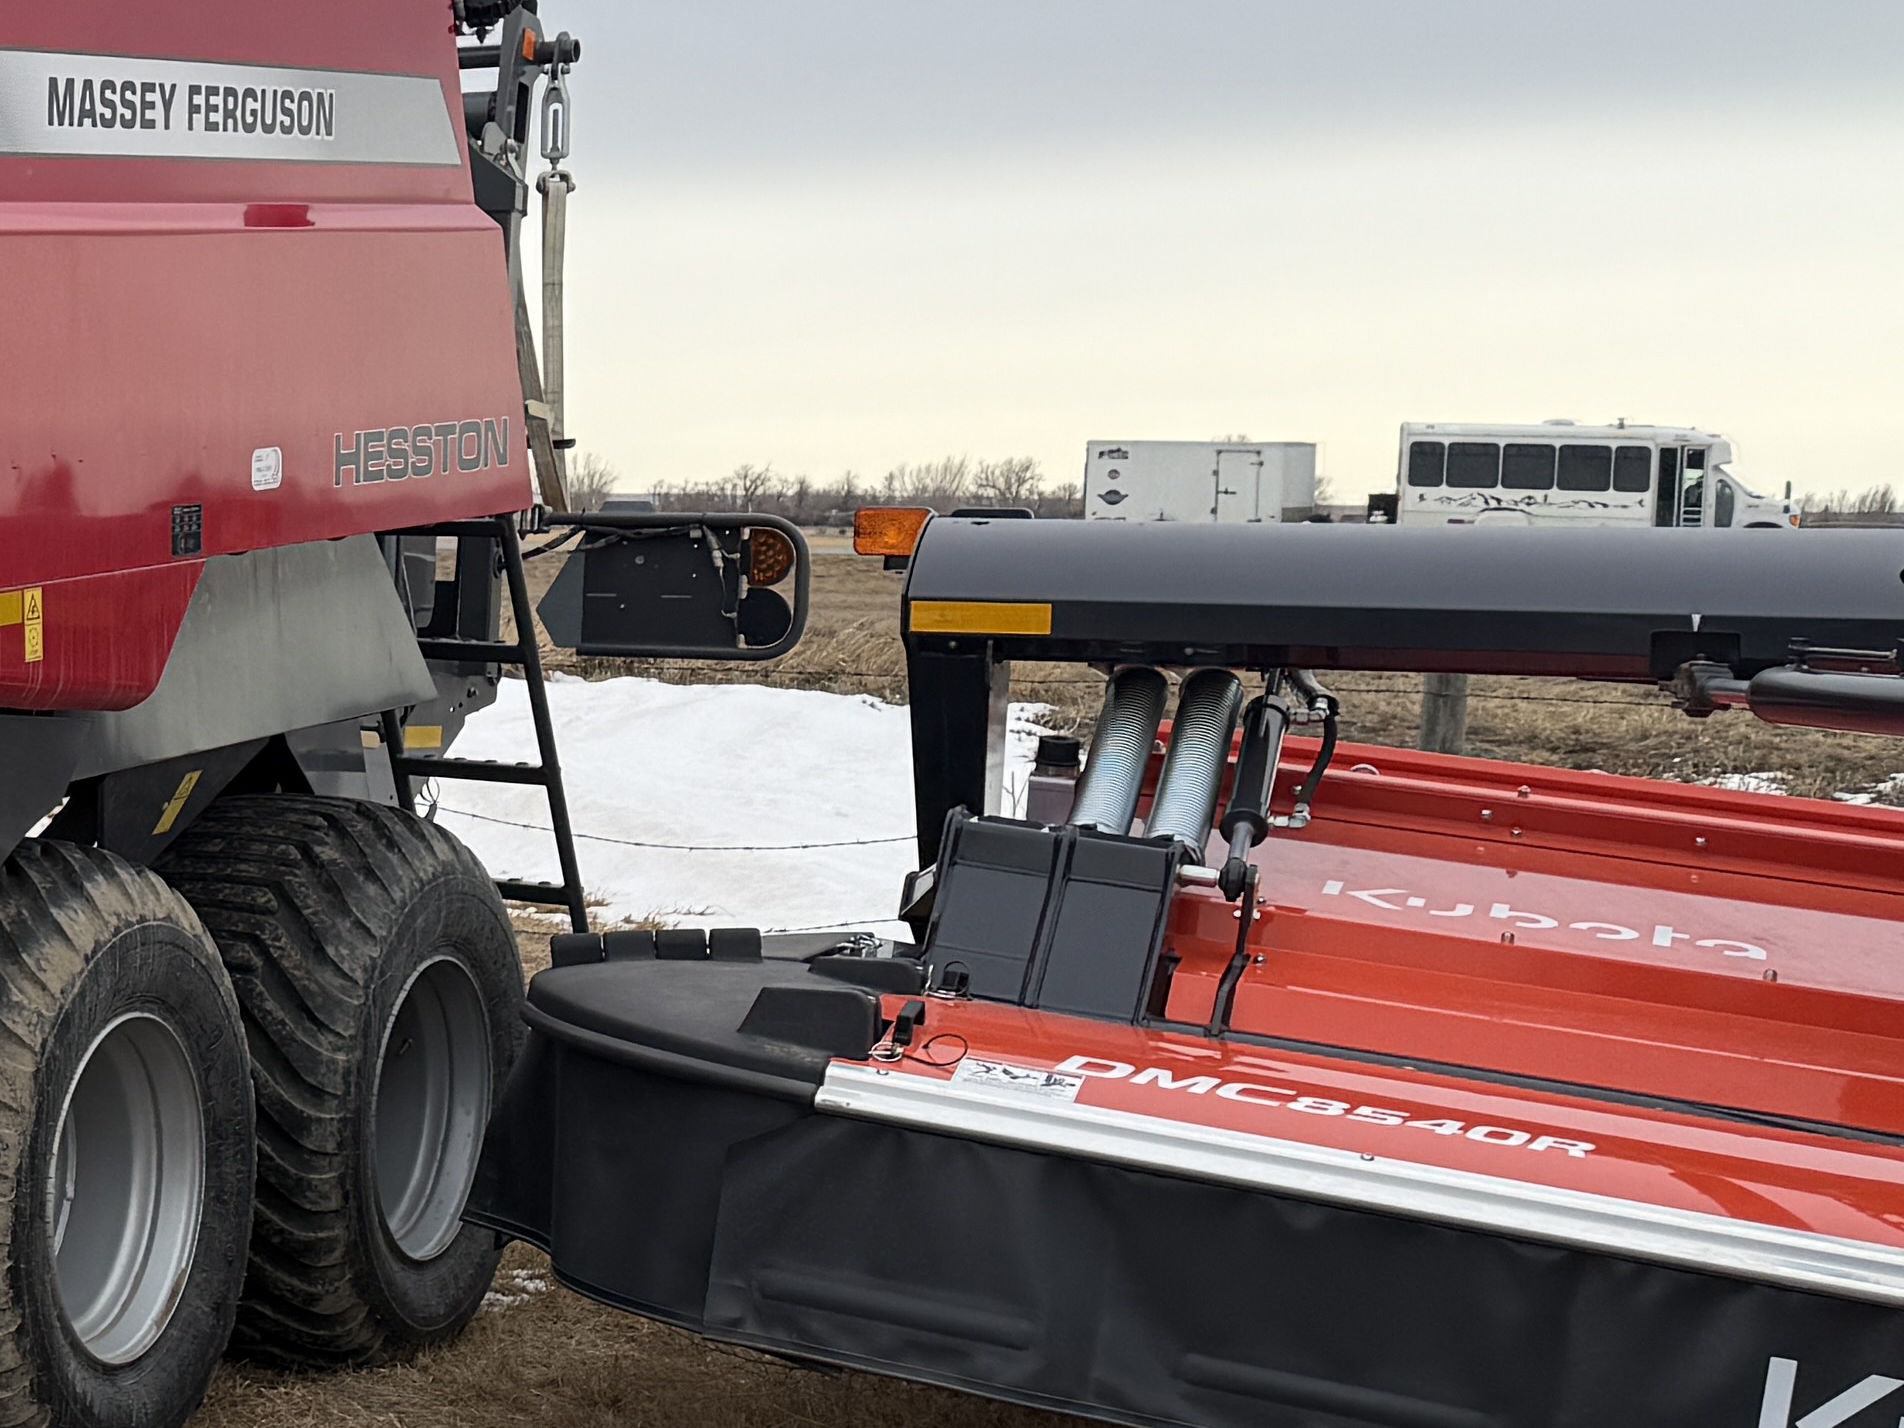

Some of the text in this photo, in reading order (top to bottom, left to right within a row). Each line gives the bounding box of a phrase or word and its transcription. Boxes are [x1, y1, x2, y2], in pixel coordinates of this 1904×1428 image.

[47, 76, 178, 131] MASSEY
[187, 83, 335, 138] FERGUSON
[333, 415, 510, 488] HESSTON
[1322, 879, 1768, 962] Kubota
[1053, 1054, 1597, 1159] DMC8540R
